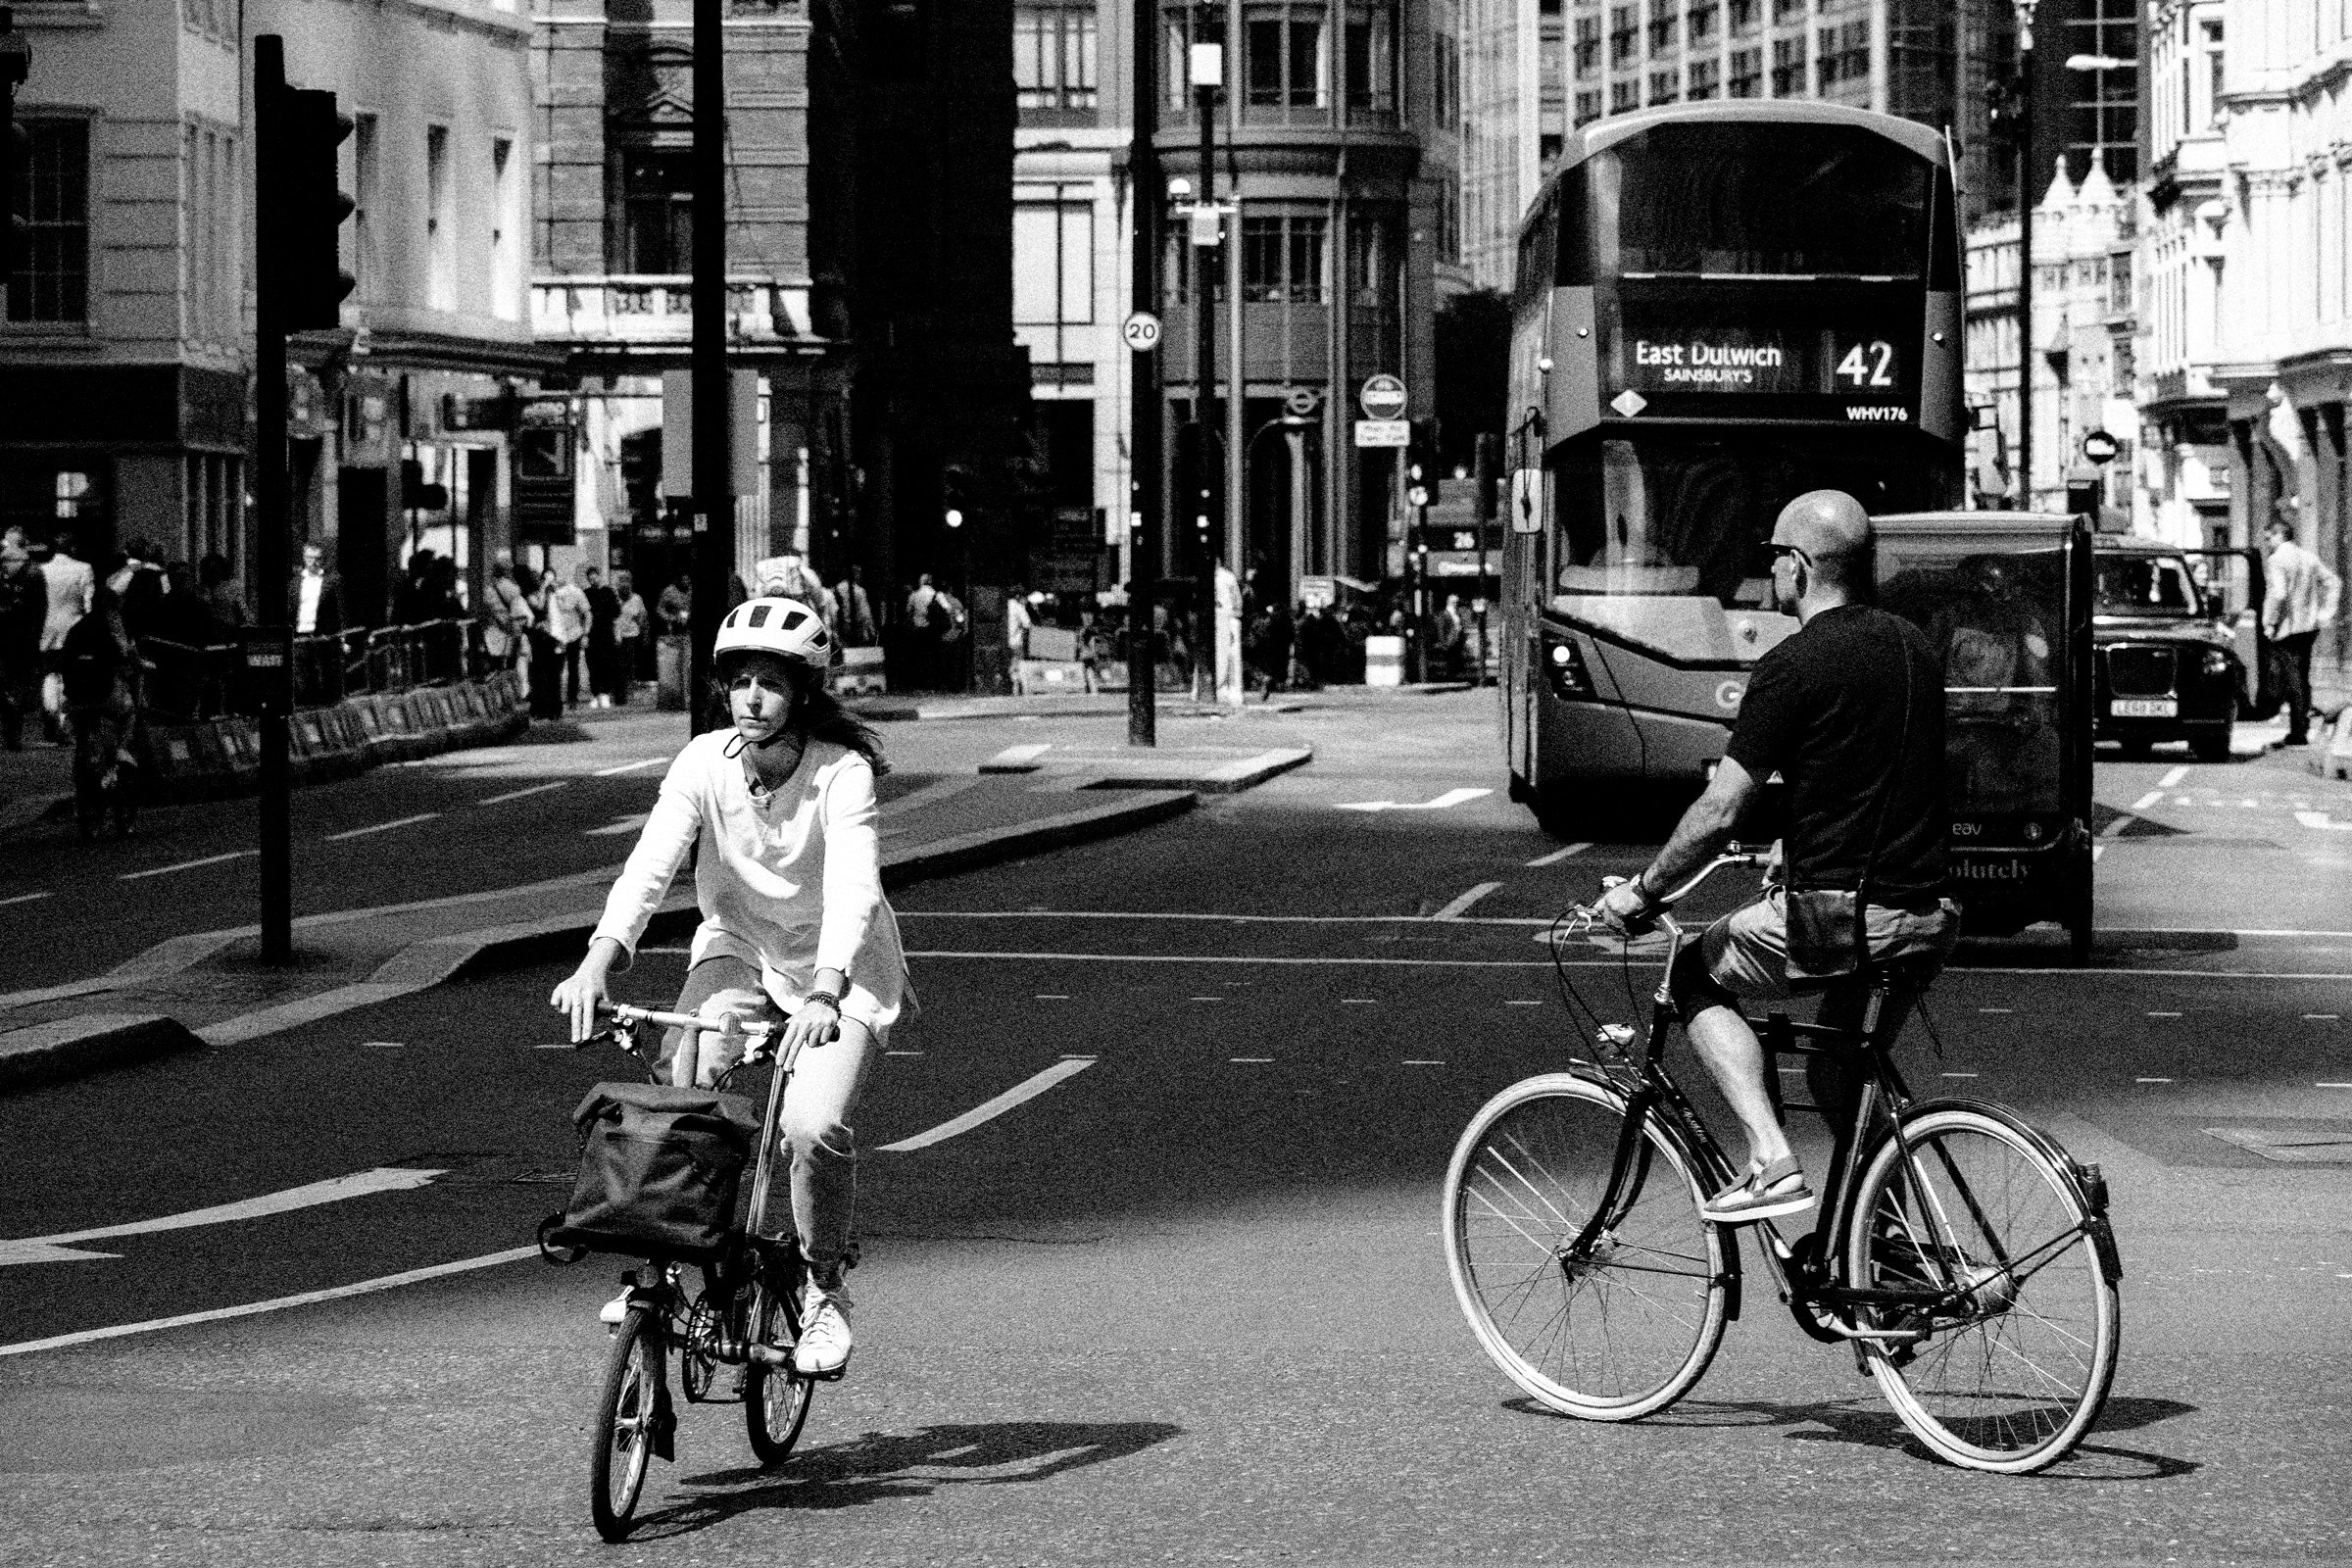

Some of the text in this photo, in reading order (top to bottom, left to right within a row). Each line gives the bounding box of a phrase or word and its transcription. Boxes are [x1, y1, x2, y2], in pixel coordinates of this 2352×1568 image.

[1129, 323, 1155, 339] 20
[1636, 341, 1782, 367] East Dulwich
[1836, 341, 1892, 385] 42
[1663, 368, 1754, 384] SAINSBURY'S
[1846, 406, 1909, 421] WHV176
[1952, 822, 1983, 836] eav
[1948, 858, 2032, 884] olutely
